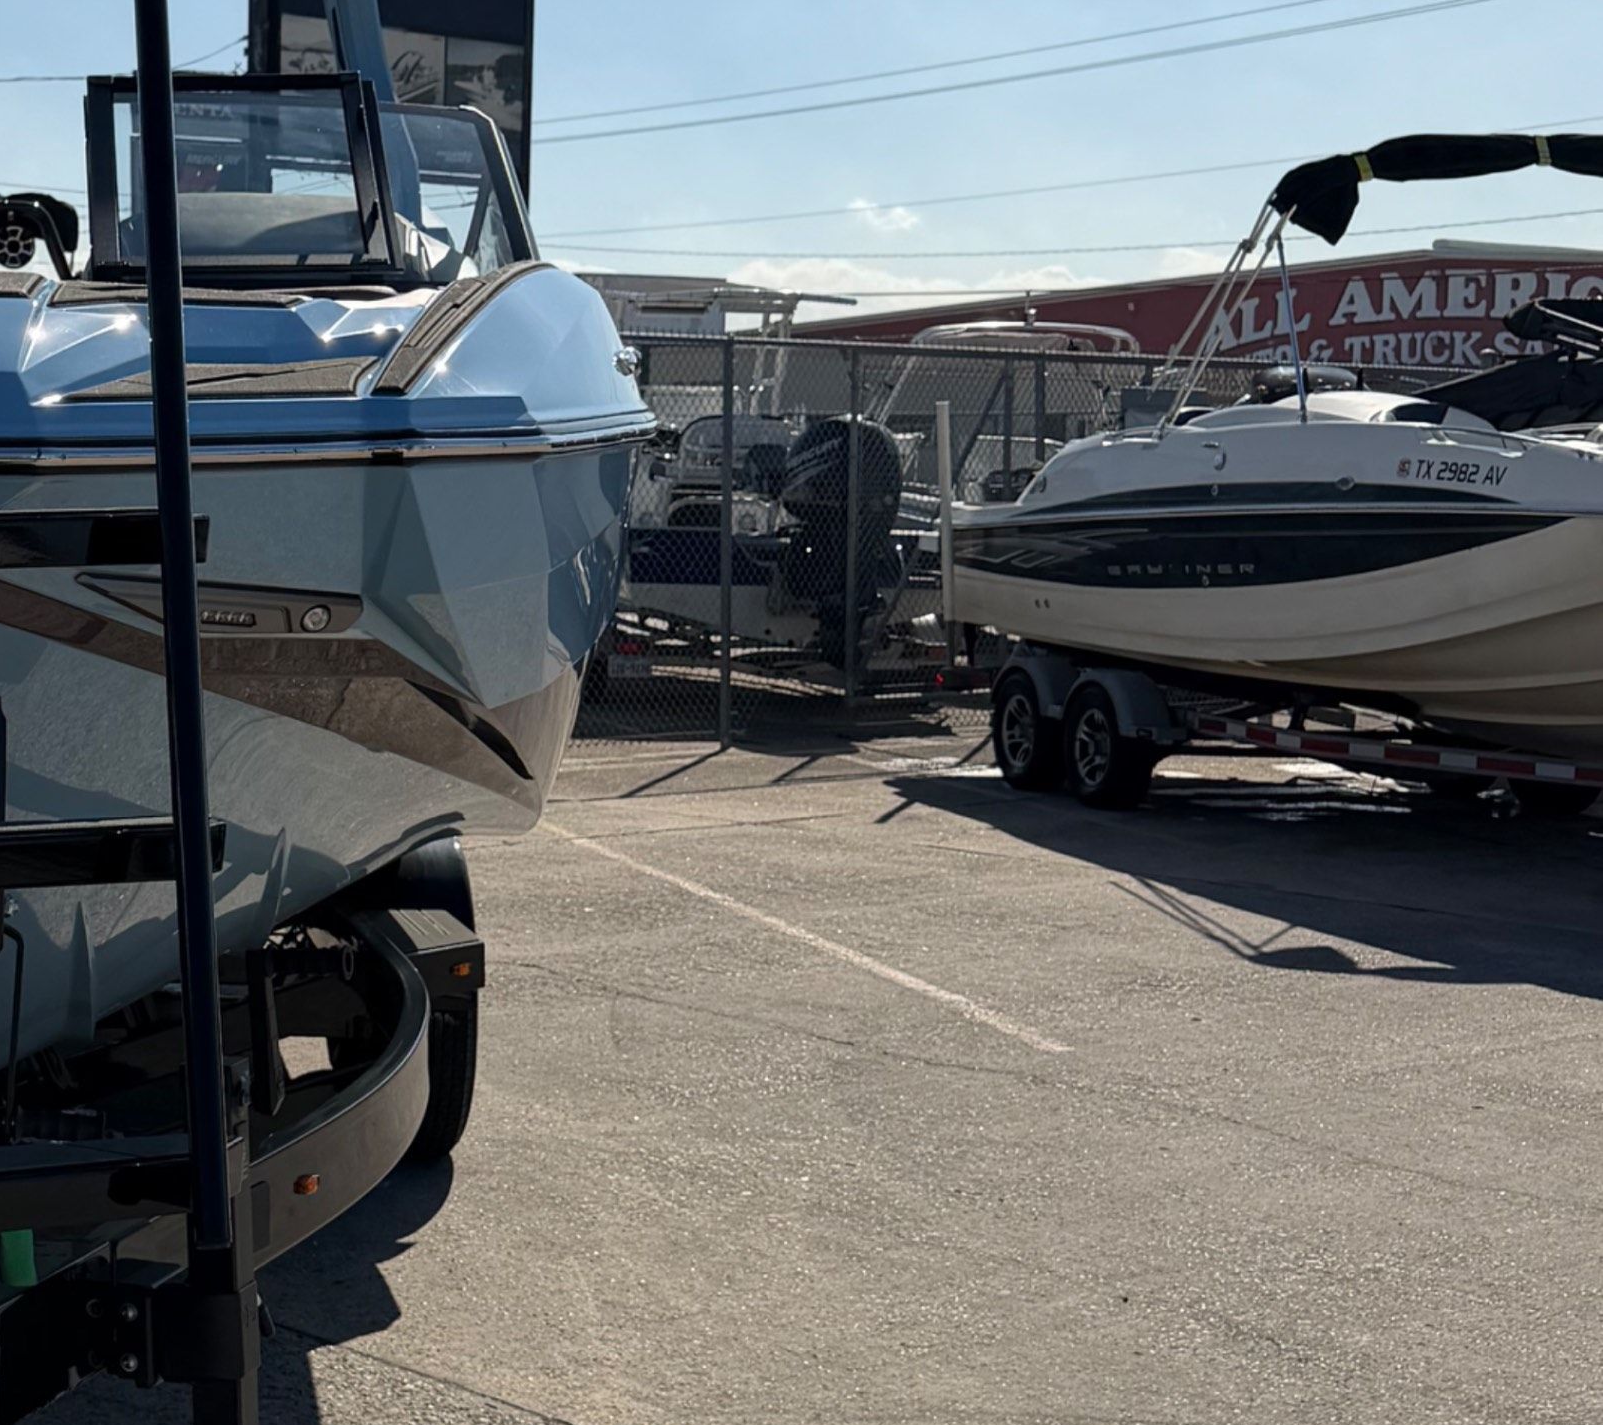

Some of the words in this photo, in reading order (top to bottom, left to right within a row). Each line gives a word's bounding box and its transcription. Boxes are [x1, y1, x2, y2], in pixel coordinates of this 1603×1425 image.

[1200, 288, 1312, 355] ALL
[1344, 331, 1483, 366] TRUCK
[1415, 459, 1435, 480] TX
[1437, 461, 1480, 484] 2982
[1481, 464, 1508, 486] AV
